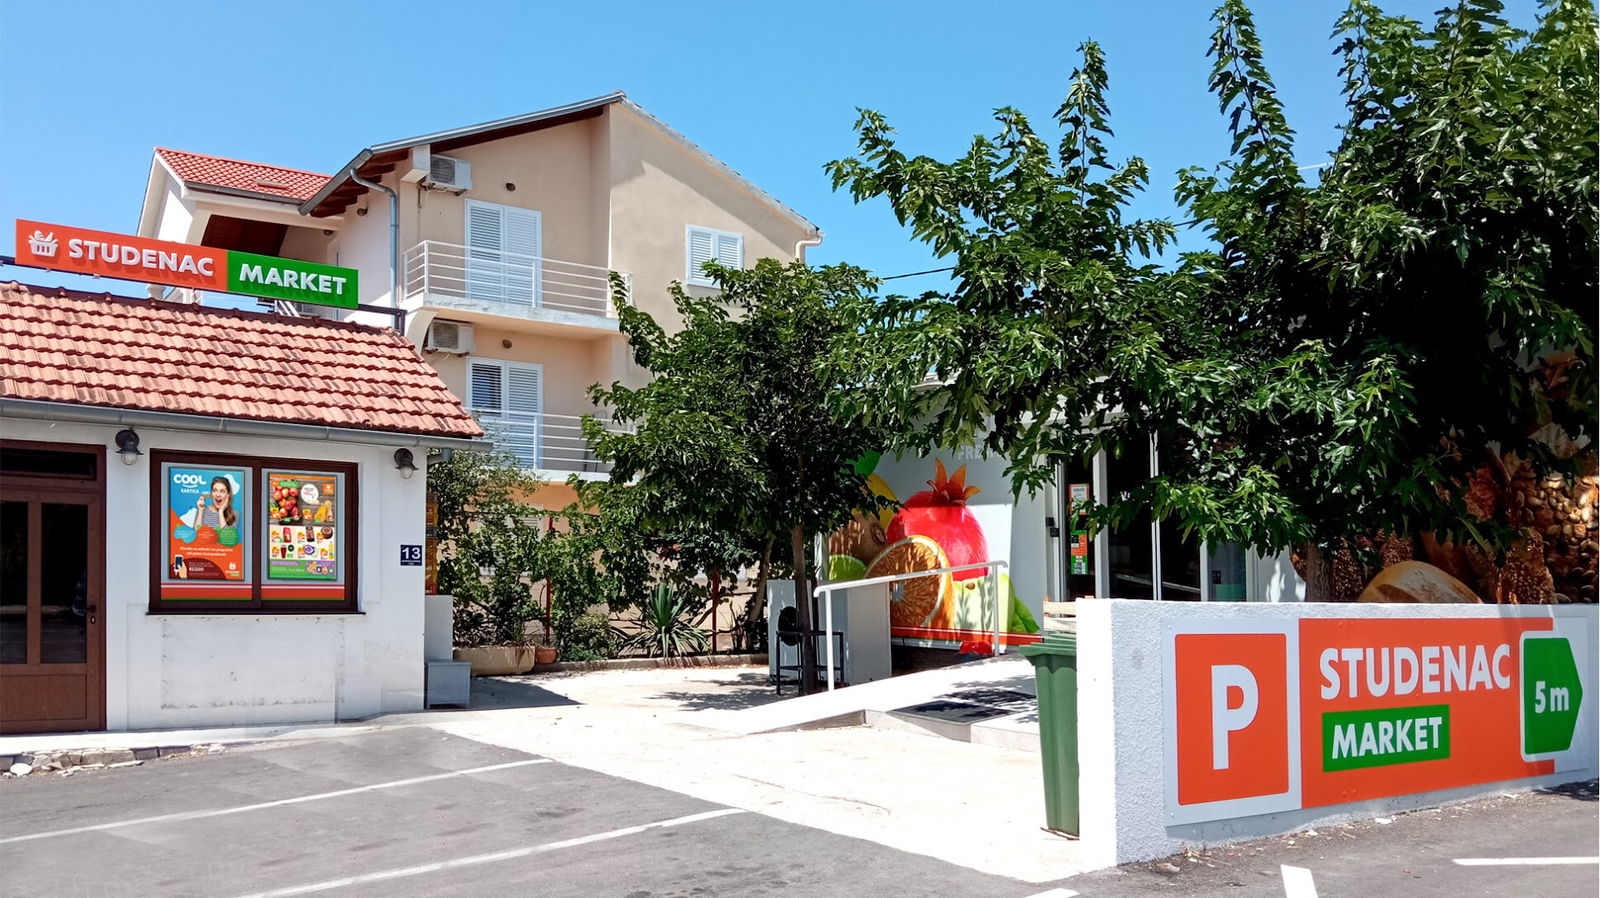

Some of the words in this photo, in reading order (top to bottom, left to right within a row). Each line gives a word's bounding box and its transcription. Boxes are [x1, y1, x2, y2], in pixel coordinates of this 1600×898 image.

[68, 238, 215, 277] STUDENAC
[239, 263, 347, 296] MARKET
[173, 473, 207, 485] COOL
[402, 547, 421, 560] 13
[1319, 643, 1511, 700] STUDENAC
[1211, 664, 1259, 770] P
[1331, 716, 1443, 760] MARKET
